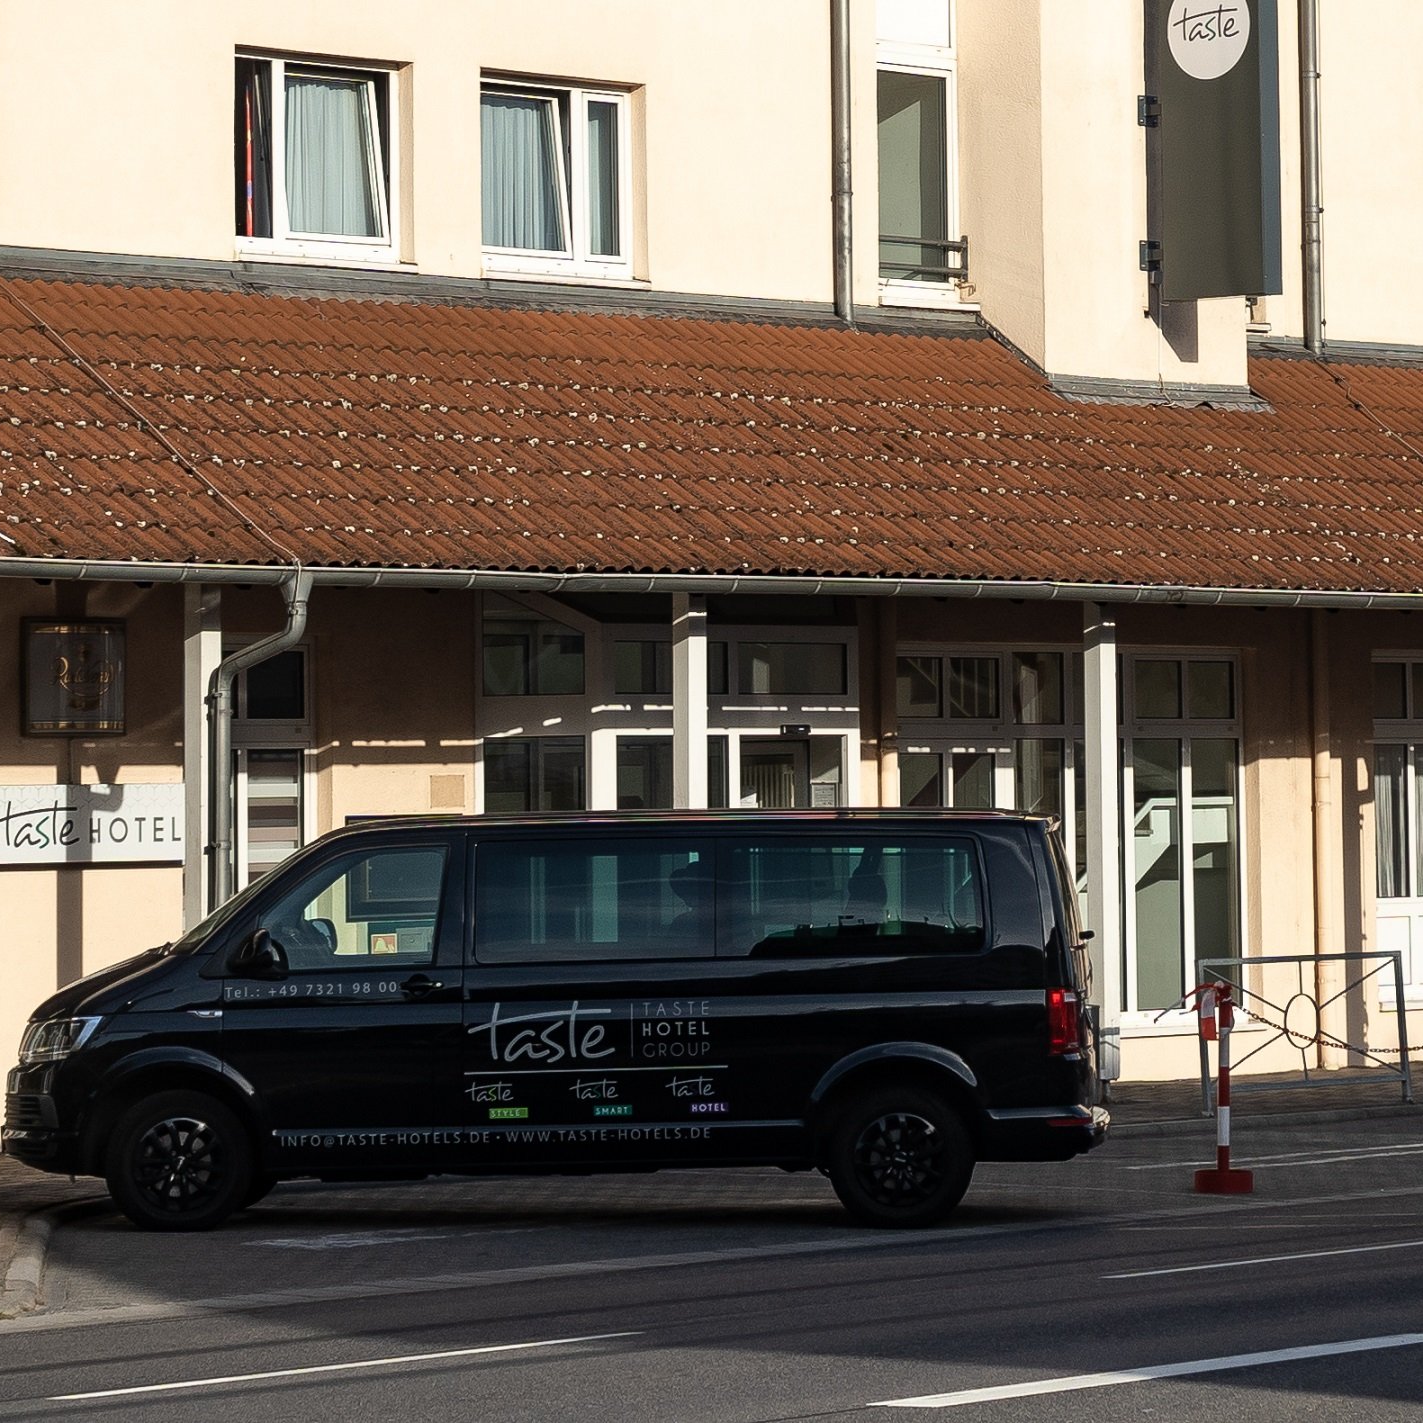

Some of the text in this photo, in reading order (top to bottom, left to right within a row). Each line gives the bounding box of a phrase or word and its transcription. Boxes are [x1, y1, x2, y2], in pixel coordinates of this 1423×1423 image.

[1173, 4, 1240, 41] taste
[89, 817, 182, 843] HOTEL
[225, 981, 397, 999] Tel.: +49 7321 98 00
[642, 1001, 710, 1016] TASTE
[467, 1000, 615, 1063] taste
[642, 1021, 710, 1036] HOTEL
[642, 1042, 711, 1058] GROUP
[464, 1081, 514, 1102] taste
[569, 1079, 619, 1099] taste
[665, 1076, 715, 1096] taste
[490, 1108, 521, 1117] STYLE
[595, 1106, 629, 1115] SMART
[691, 1103, 726, 1112] HOTEL
[281, 1127, 711, 1146] INFO@TASTE-HOTELS.DE WWW.TASTE-HOTELS.DE
